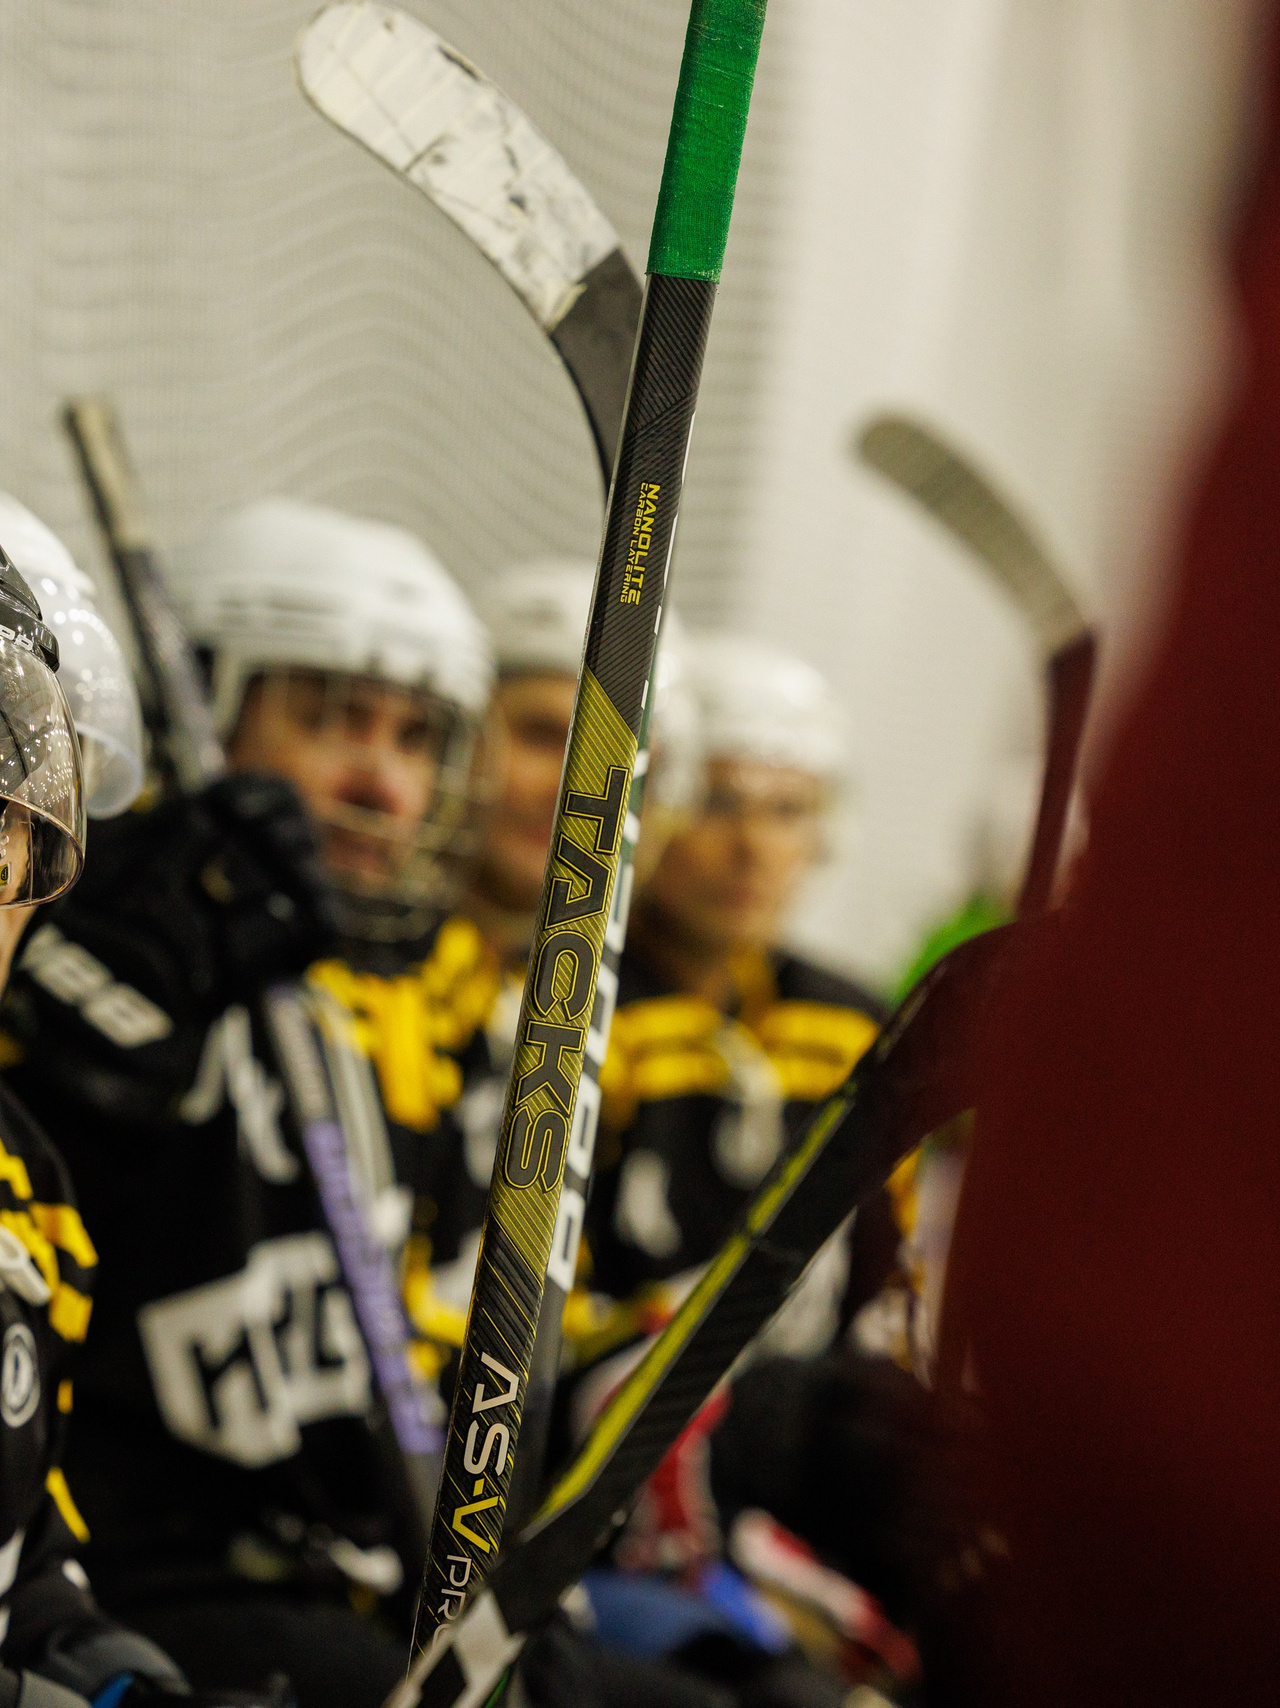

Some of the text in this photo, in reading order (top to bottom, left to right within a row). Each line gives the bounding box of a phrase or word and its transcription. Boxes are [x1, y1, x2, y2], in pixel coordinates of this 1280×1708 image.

[620, 482, 648, 603] CARBON LAYERING
[627, 483, 661, 606] NANOLITE
[504, 765, 630, 1193] TACKS
